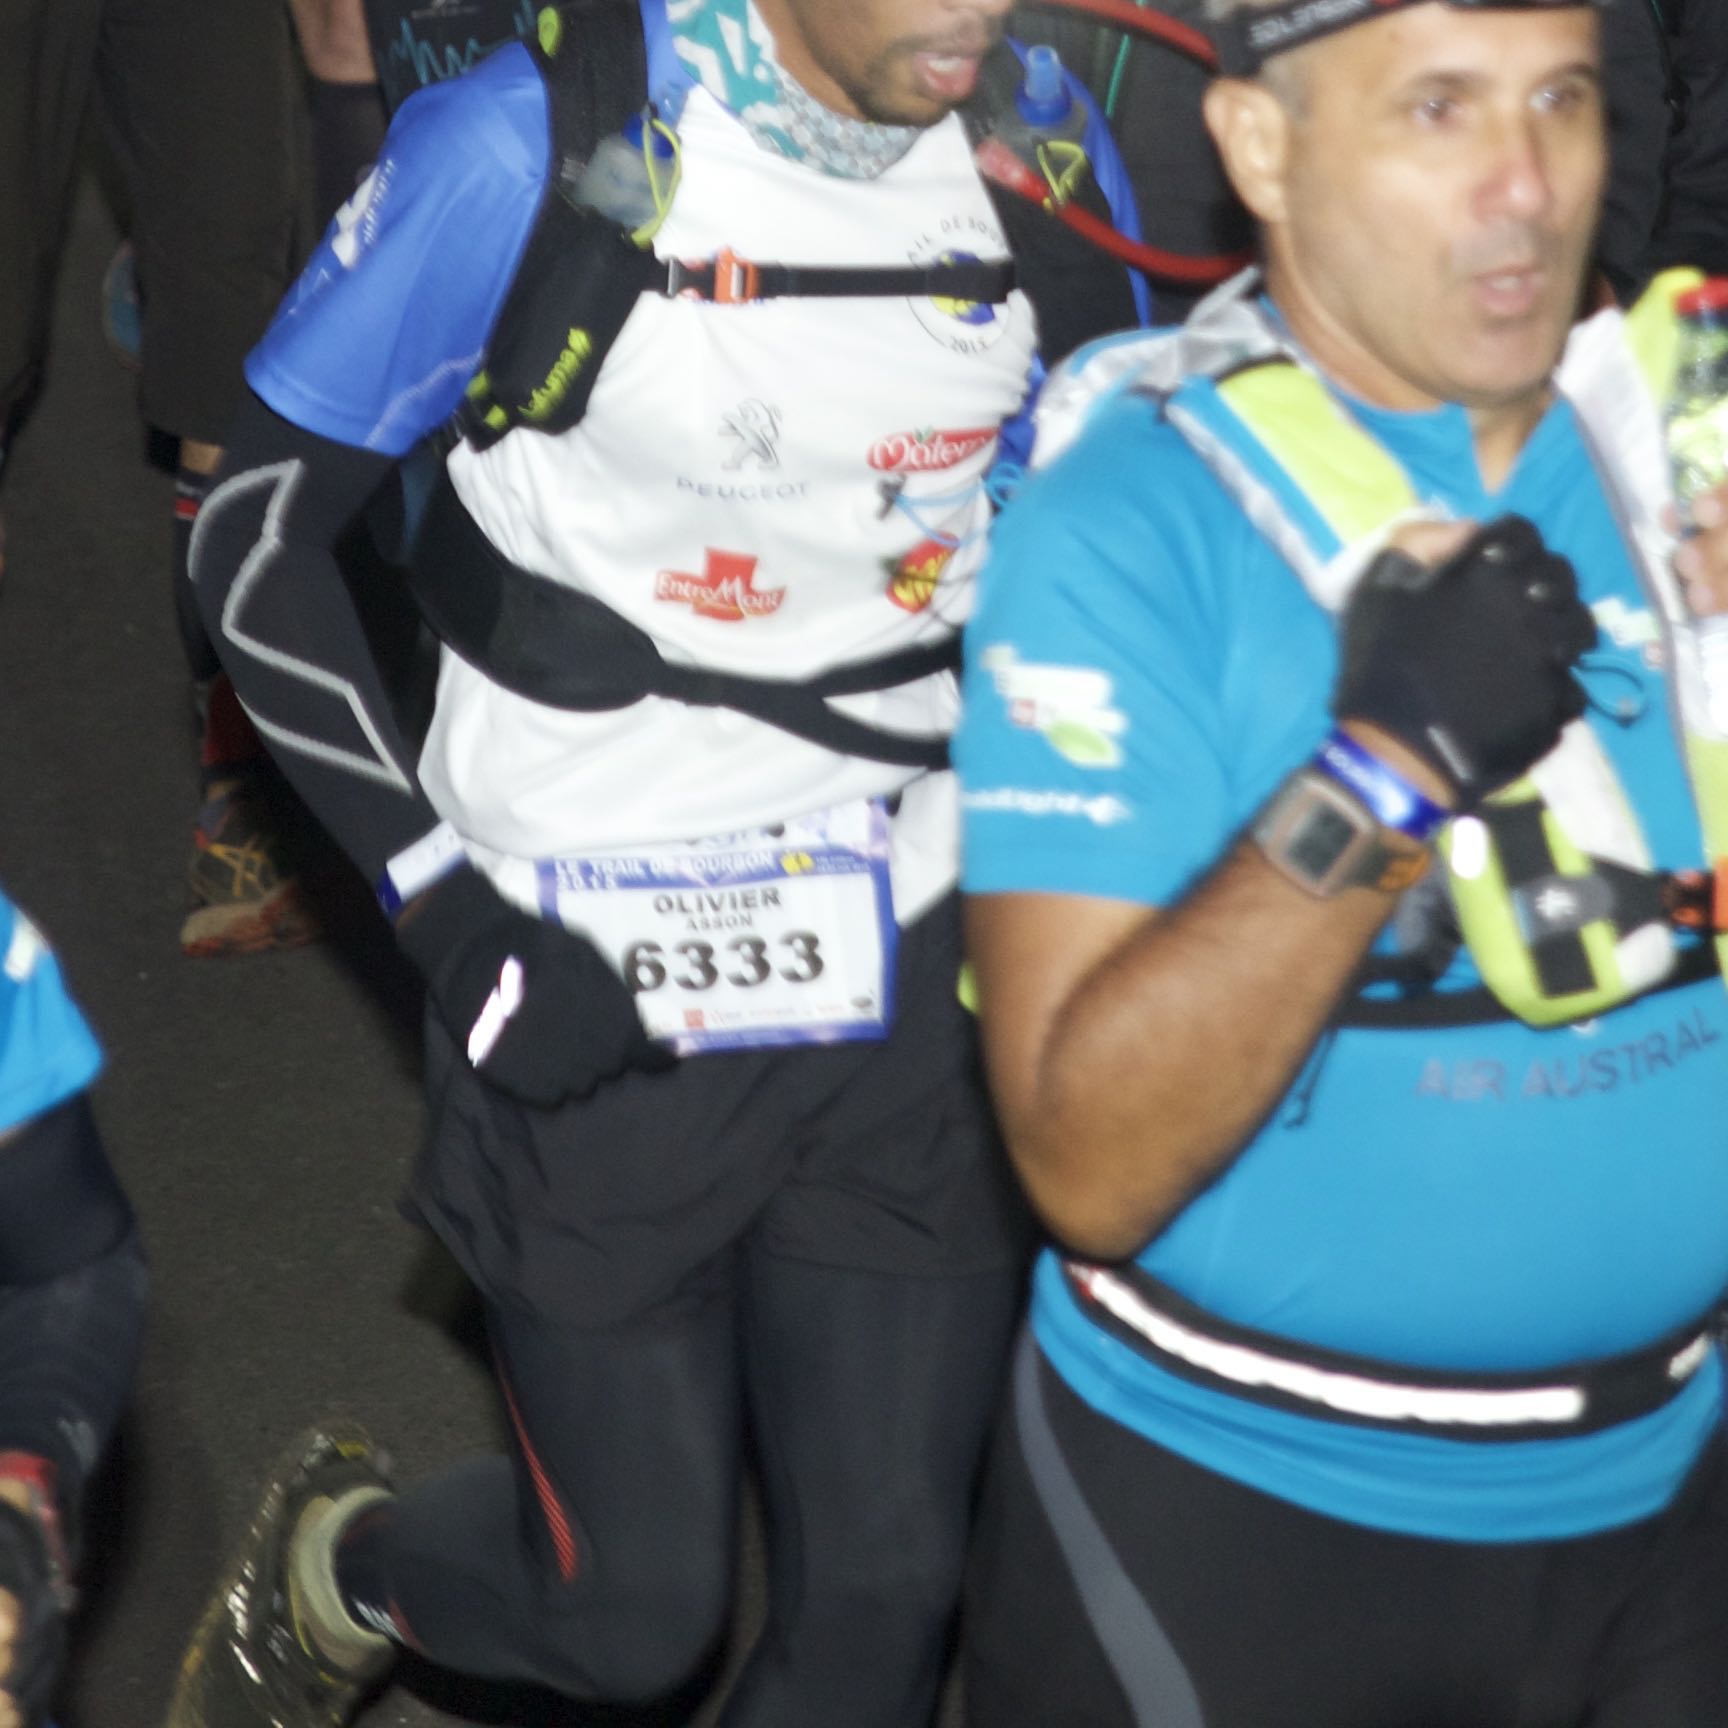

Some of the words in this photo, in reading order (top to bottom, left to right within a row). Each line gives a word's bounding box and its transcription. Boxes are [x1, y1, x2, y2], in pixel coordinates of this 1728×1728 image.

[676, 477, 808, 502] PEUGEOT
[653, 886, 782, 916] OLIVIER
[685, 913, 754, 932] ASSON
[622, 929, 826, 994] 6333
[1415, 1057, 1509, 1102] AIR
[1522, 1007, 1721, 1101] AUSTRAL
